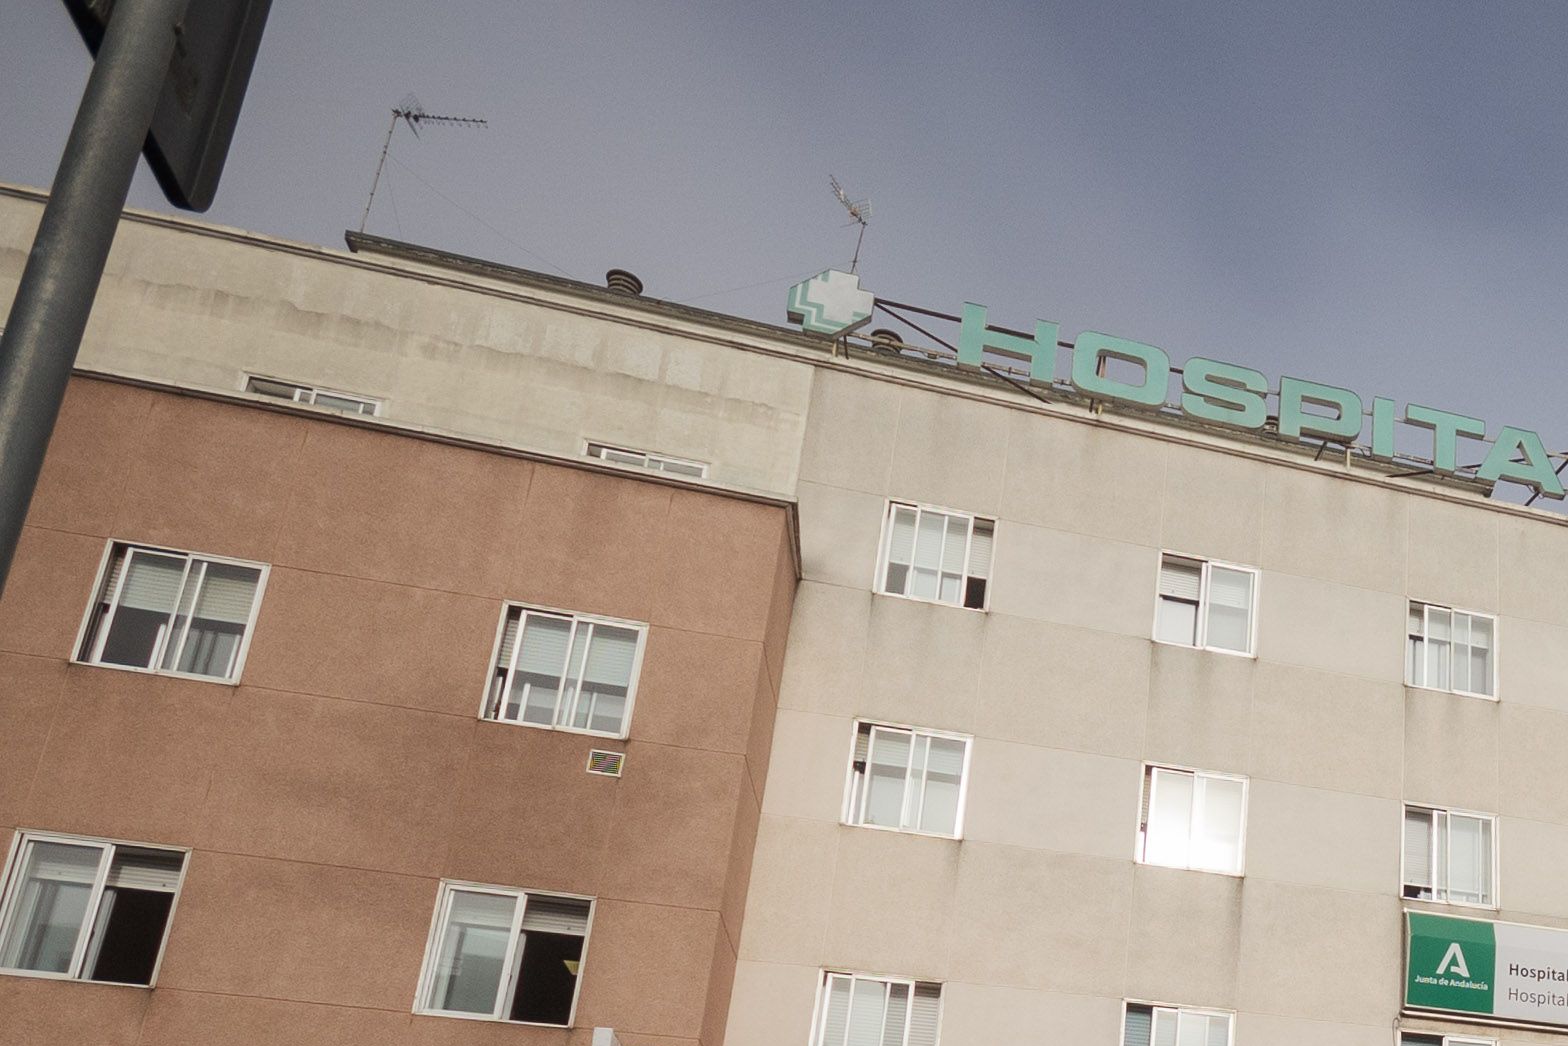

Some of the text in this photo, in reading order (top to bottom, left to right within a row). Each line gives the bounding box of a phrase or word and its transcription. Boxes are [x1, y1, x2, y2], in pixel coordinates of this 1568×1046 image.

[1414, 974, 1489, 991] Junta de Andalucía
